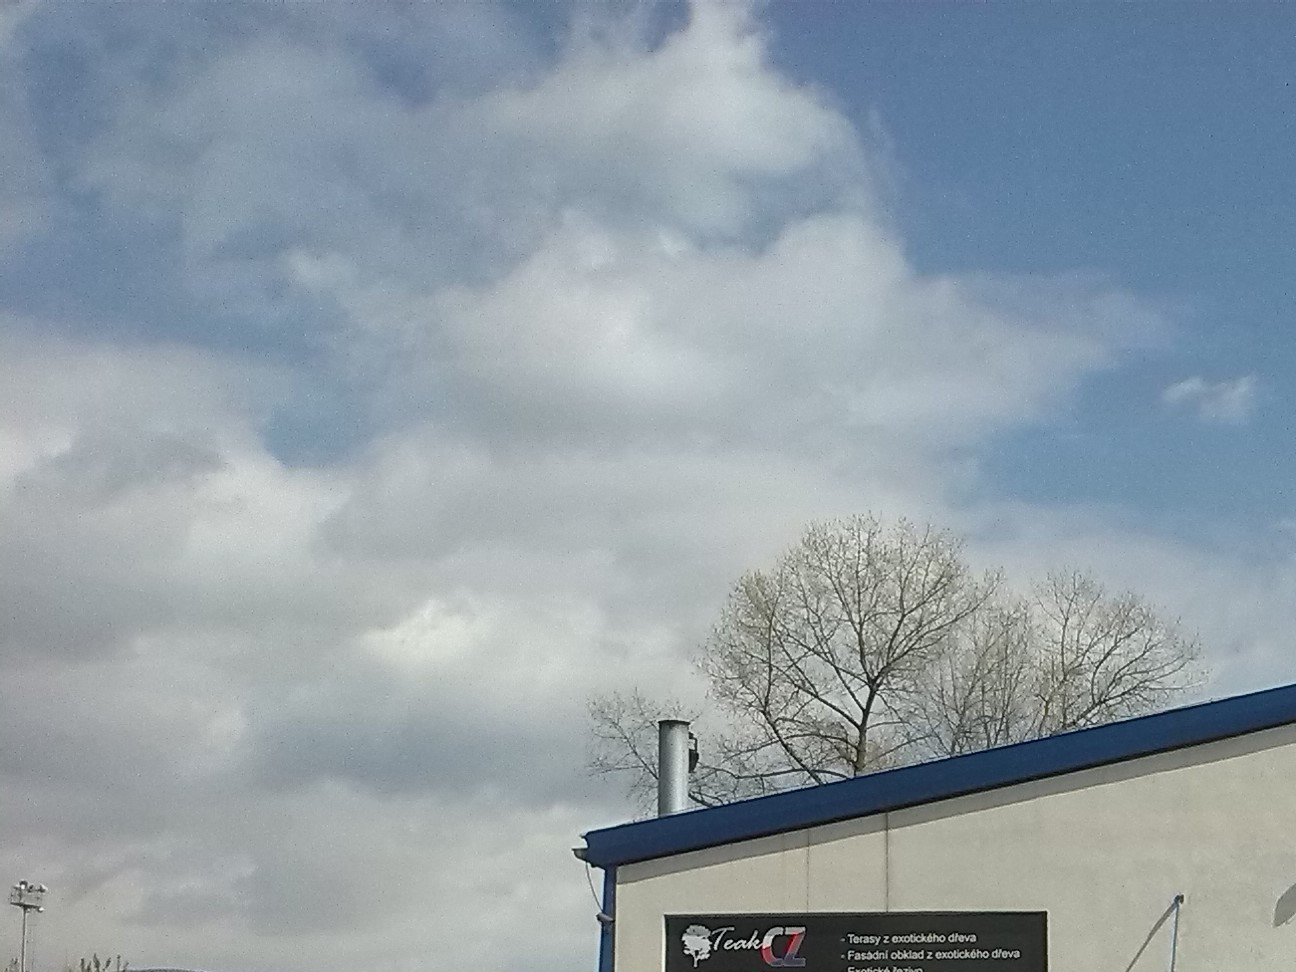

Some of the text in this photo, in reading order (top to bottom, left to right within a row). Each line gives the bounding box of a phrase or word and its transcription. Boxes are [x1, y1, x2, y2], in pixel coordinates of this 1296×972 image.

[847, 932, 977, 946] Terasy z exotického dřeva
[847, 948, 1021, 961] Fasádní obklad z exotického dřeva
